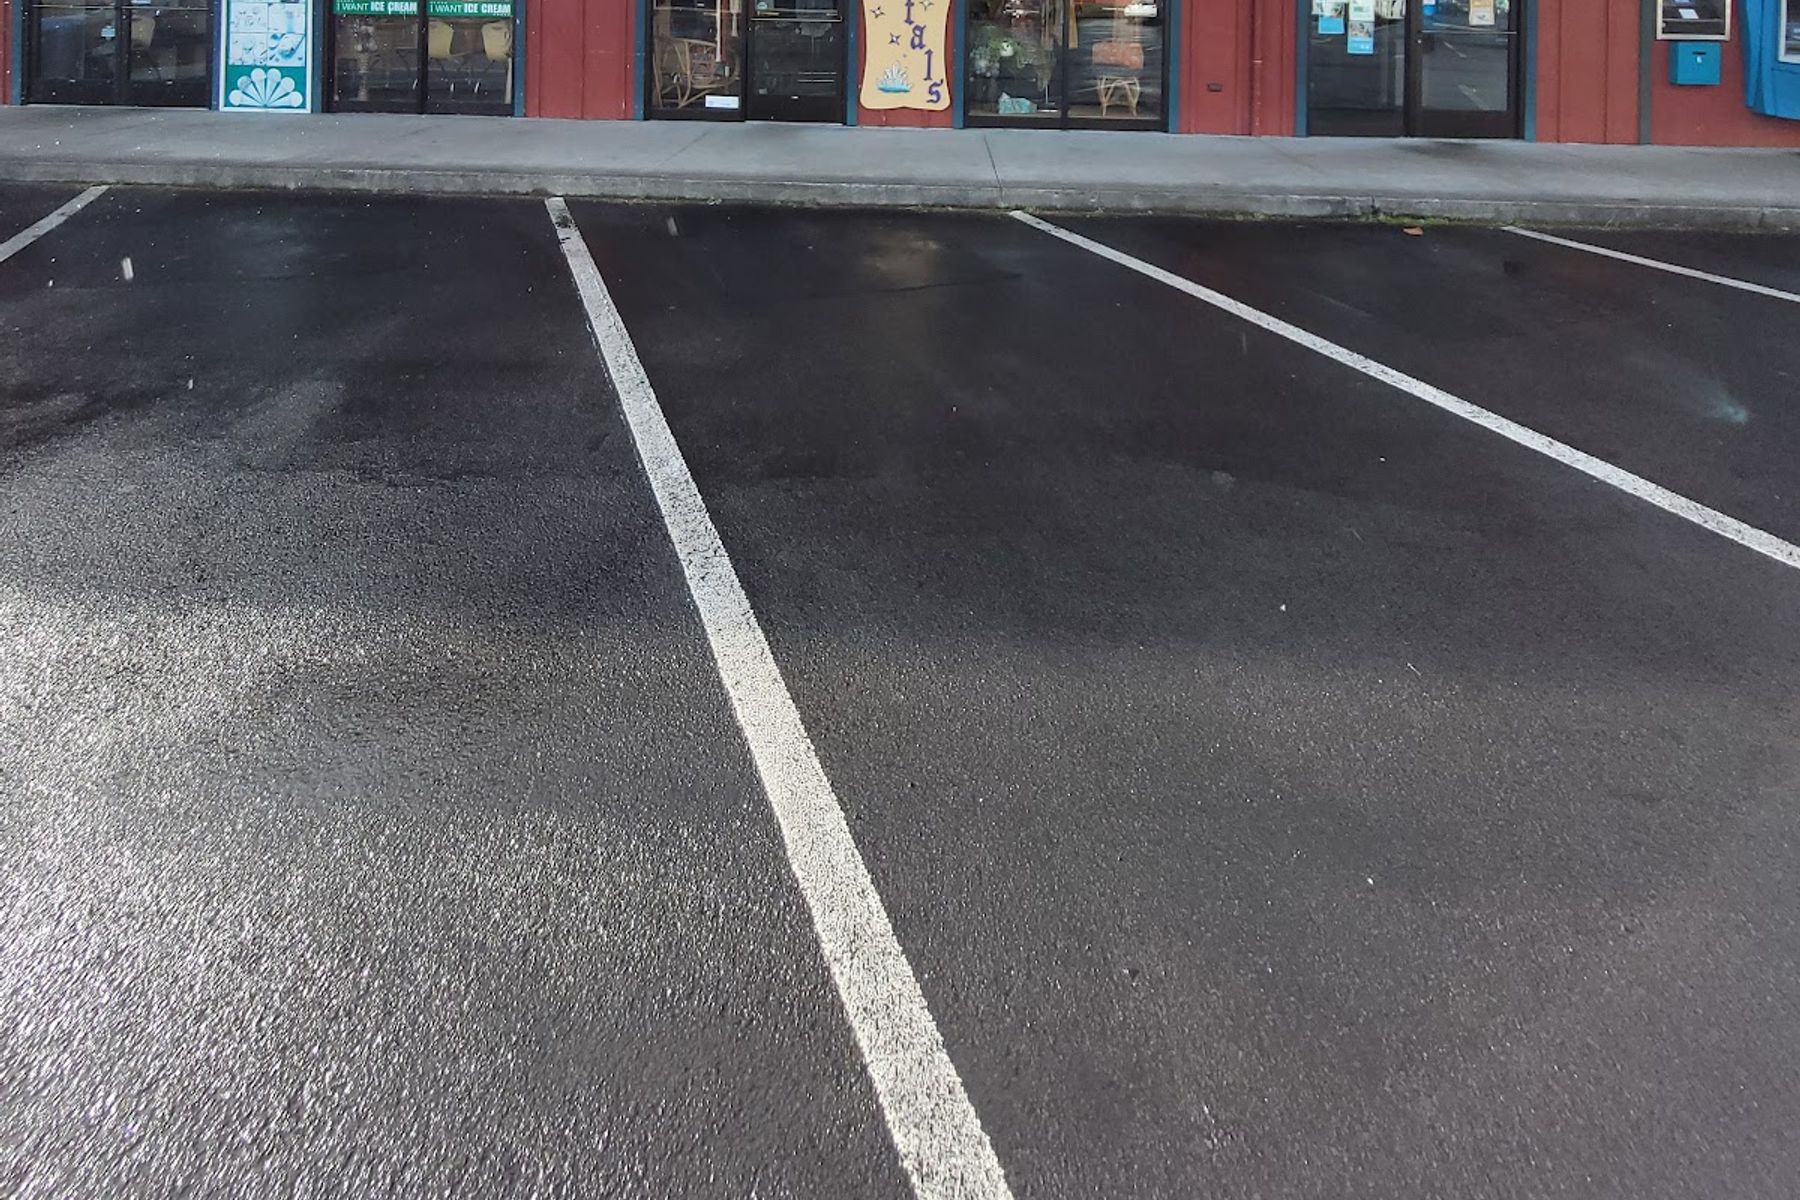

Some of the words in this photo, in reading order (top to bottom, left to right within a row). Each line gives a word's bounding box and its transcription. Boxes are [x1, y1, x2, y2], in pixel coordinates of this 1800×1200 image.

[343, 3, 369, 11] WANT
[370, 1, 385, 12] ICE
[387, 2, 417, 12] CREAM
[436, 4, 462, 13] WANT
[463, 3, 478, 13] ICE
[481, 3, 511, 13] CREAM
